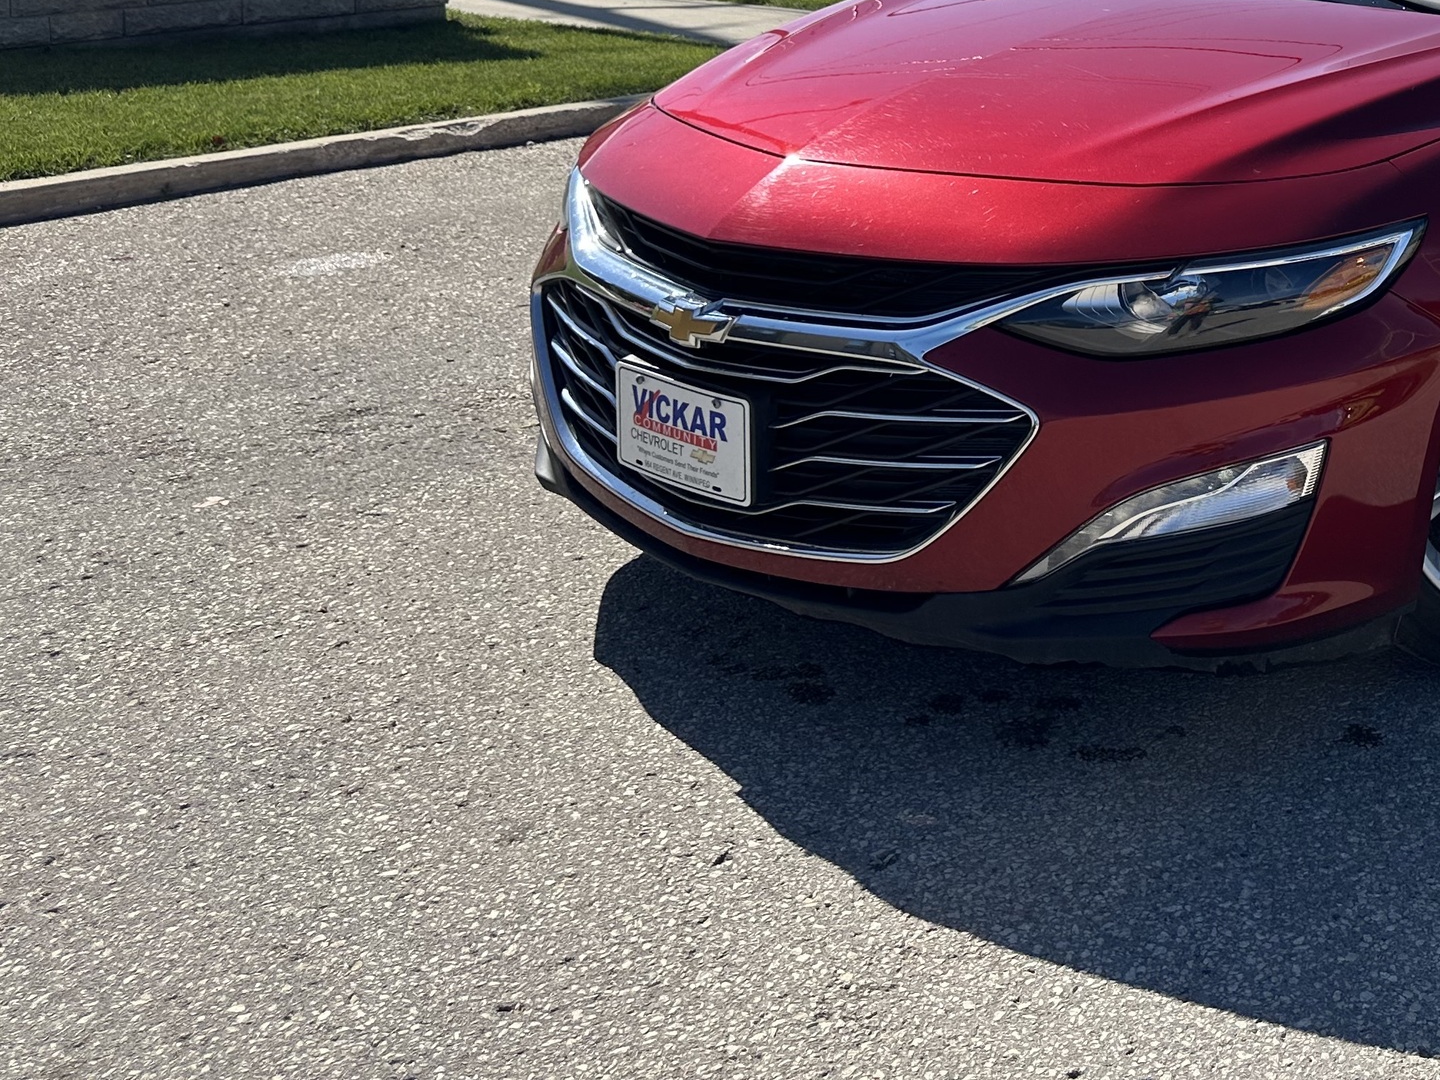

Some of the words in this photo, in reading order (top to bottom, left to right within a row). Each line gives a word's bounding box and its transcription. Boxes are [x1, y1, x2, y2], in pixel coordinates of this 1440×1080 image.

[631, 383, 728, 443] VICKAR
[630, 426, 685, 457] CHEVROLET
[634, 414, 717, 451] COMMUNITY
